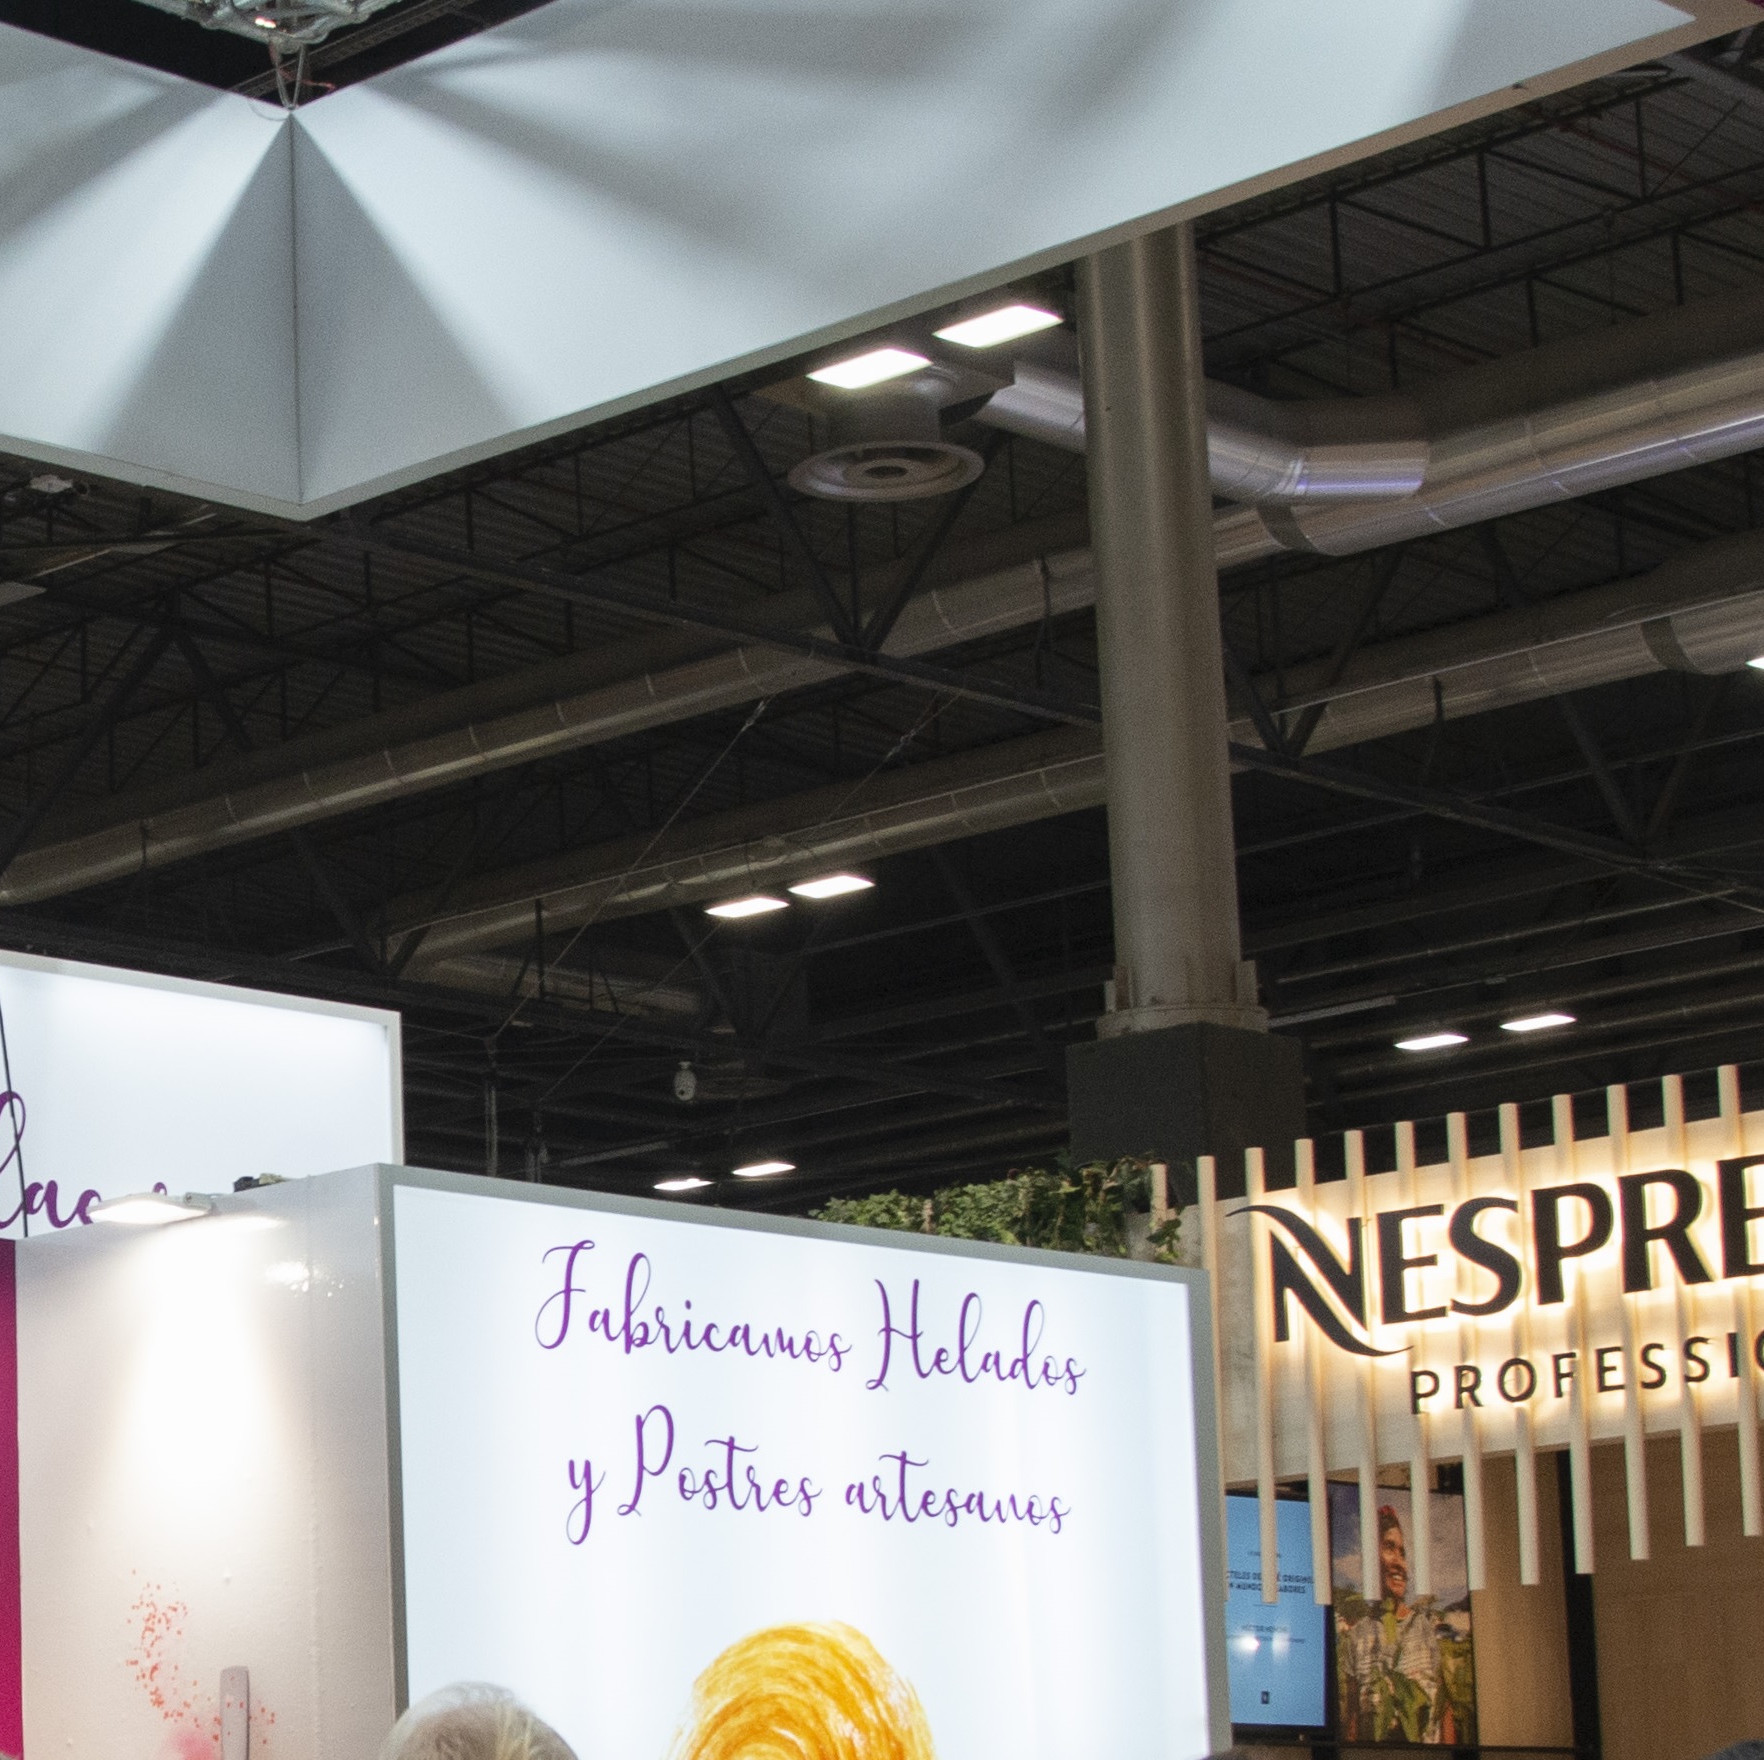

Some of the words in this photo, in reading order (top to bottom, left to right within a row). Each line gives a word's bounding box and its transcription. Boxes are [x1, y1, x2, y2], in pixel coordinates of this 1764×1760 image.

[534, 1240, 852, 1375] Fabricamos
[865, 1278, 1088, 1395] Helados
[565, 1454, 606, 1545] y
[616, 1403, 822, 1517] Postres
[844, 1450, 1072, 1535] artesanos
